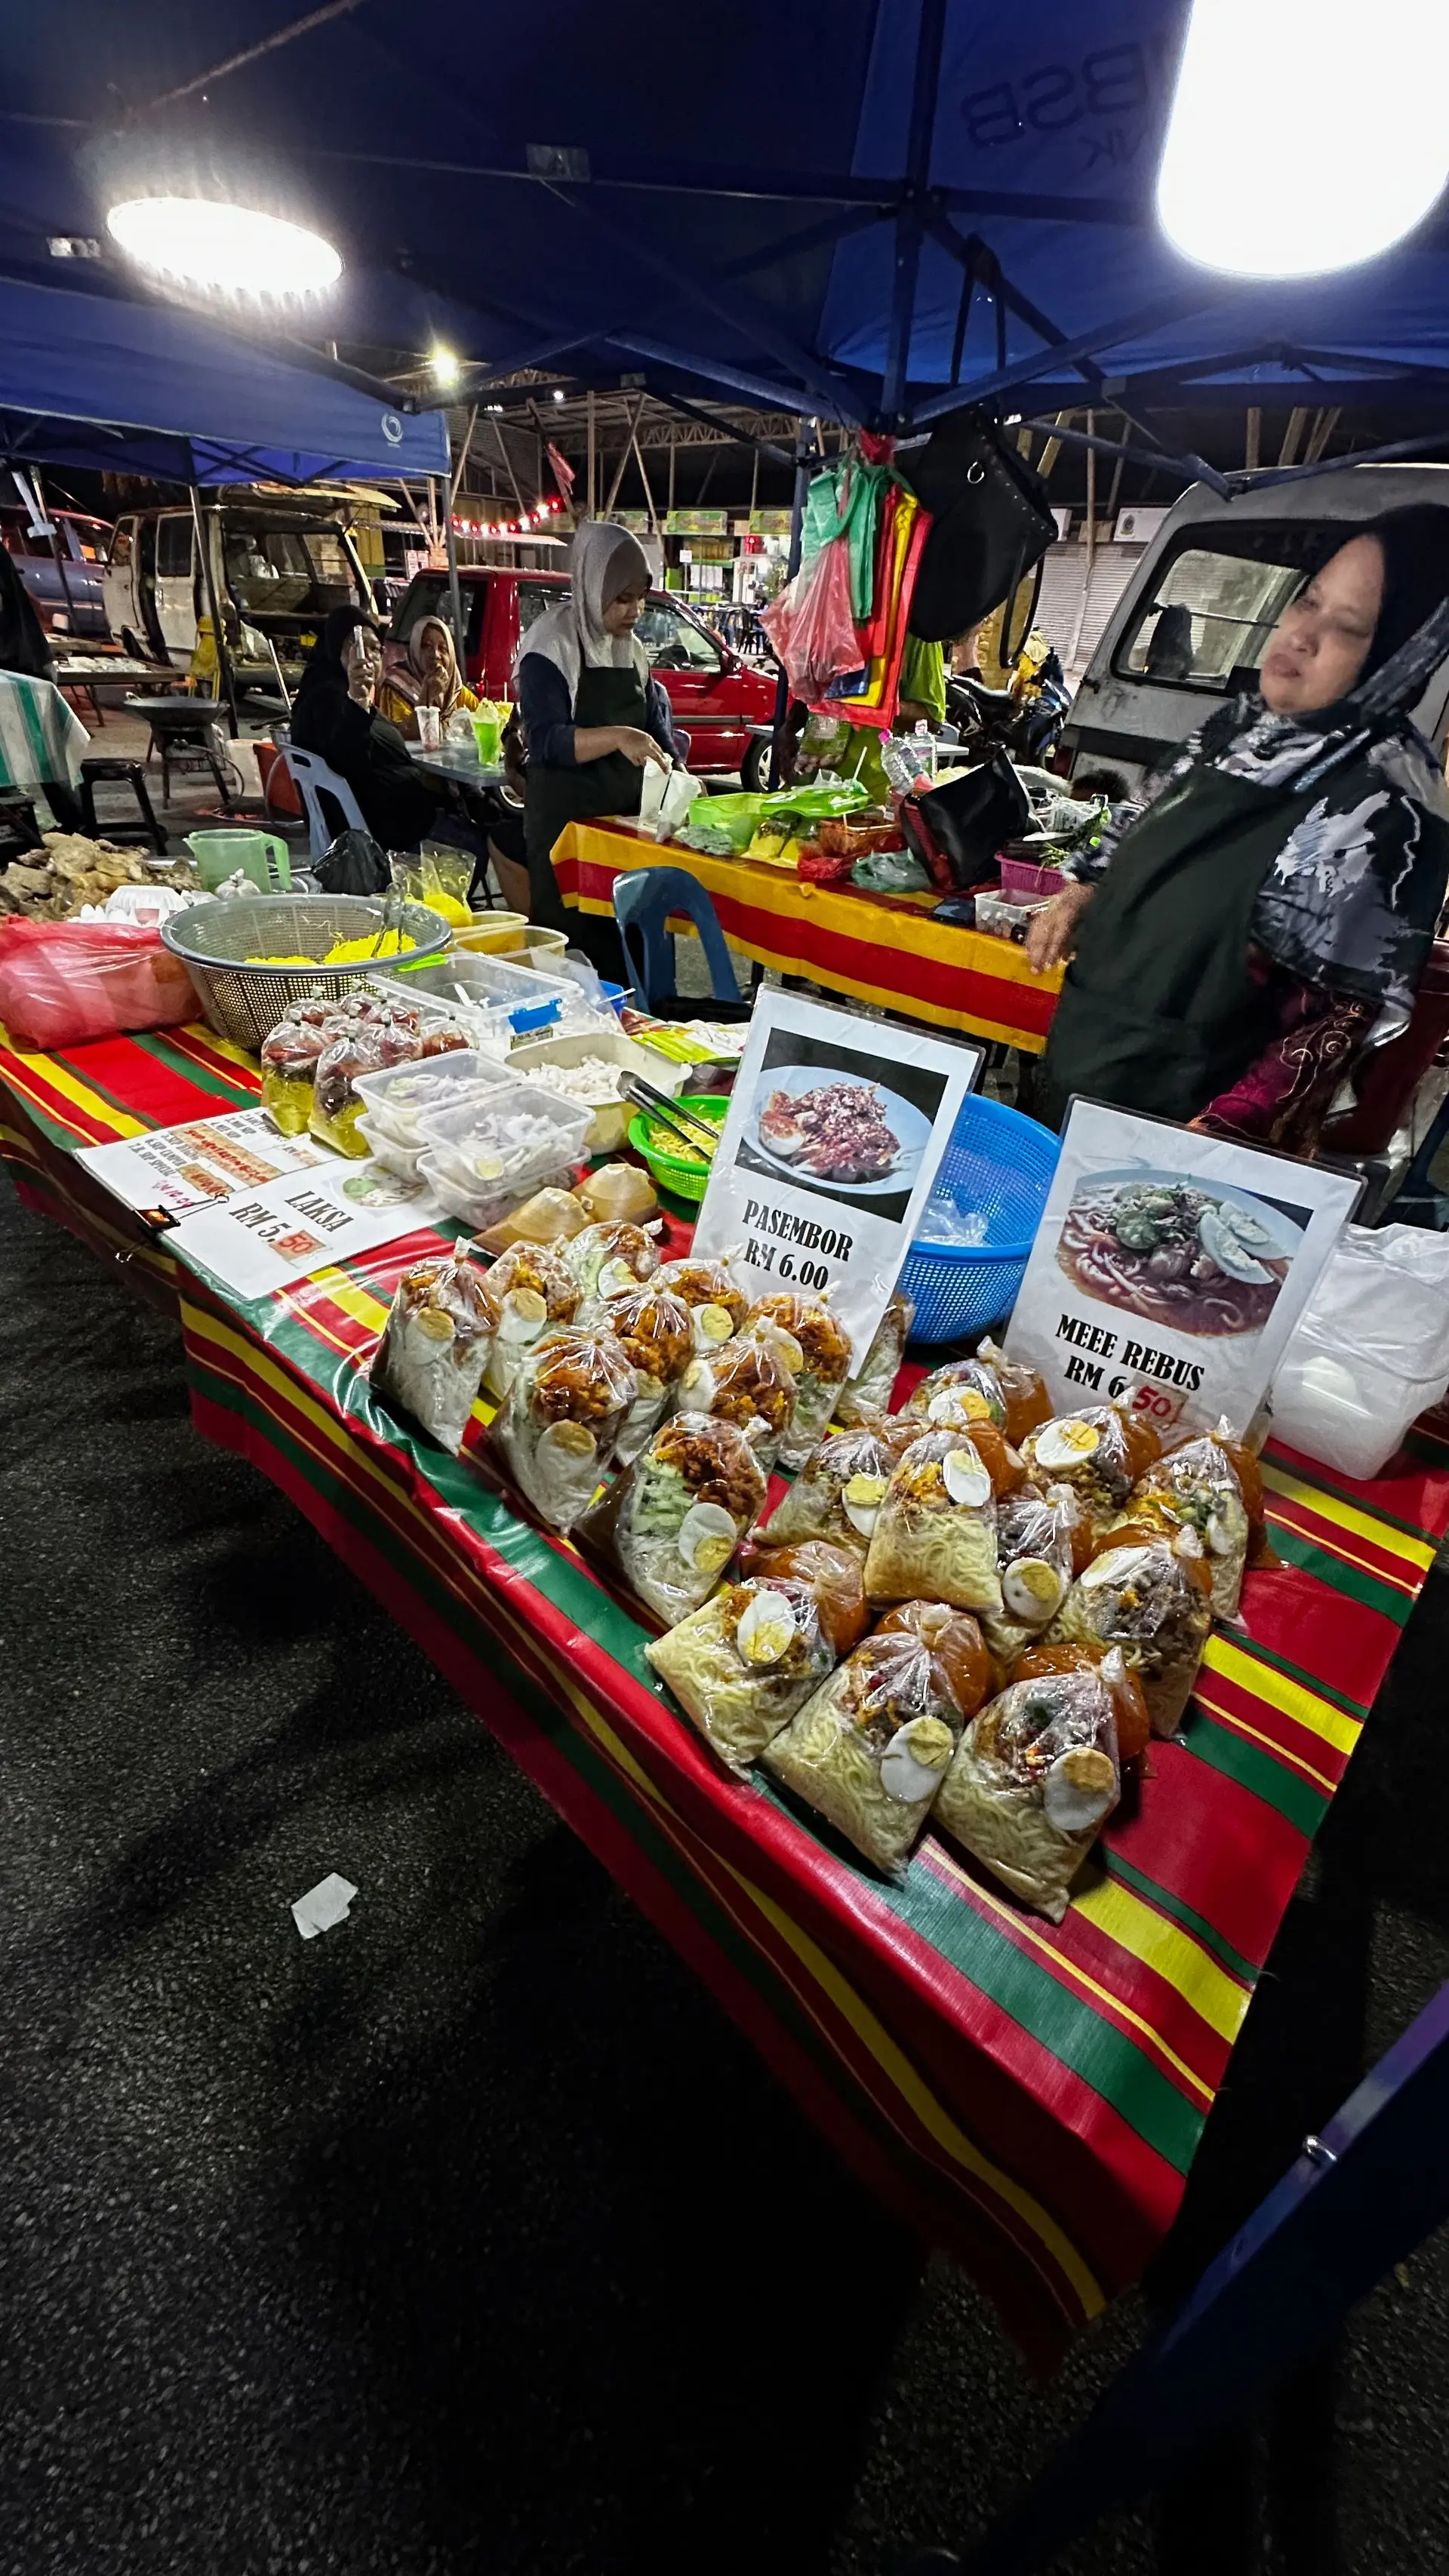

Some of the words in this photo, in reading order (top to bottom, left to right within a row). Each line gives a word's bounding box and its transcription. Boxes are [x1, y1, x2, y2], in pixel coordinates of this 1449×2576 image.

[229, 1202, 278, 1229] RM
[284, 1190, 354, 1232] LAKSA
[742, 1199, 854, 1262] PASEMBOR
[743, 1238, 777, 1272] RM
[779, 1254, 829, 1290] 6.00
[1056, 1314, 1118, 1359] MEEE
[1120, 1340, 1204, 1391] REBUS
[1064, 1356, 1106, 1391] RM
